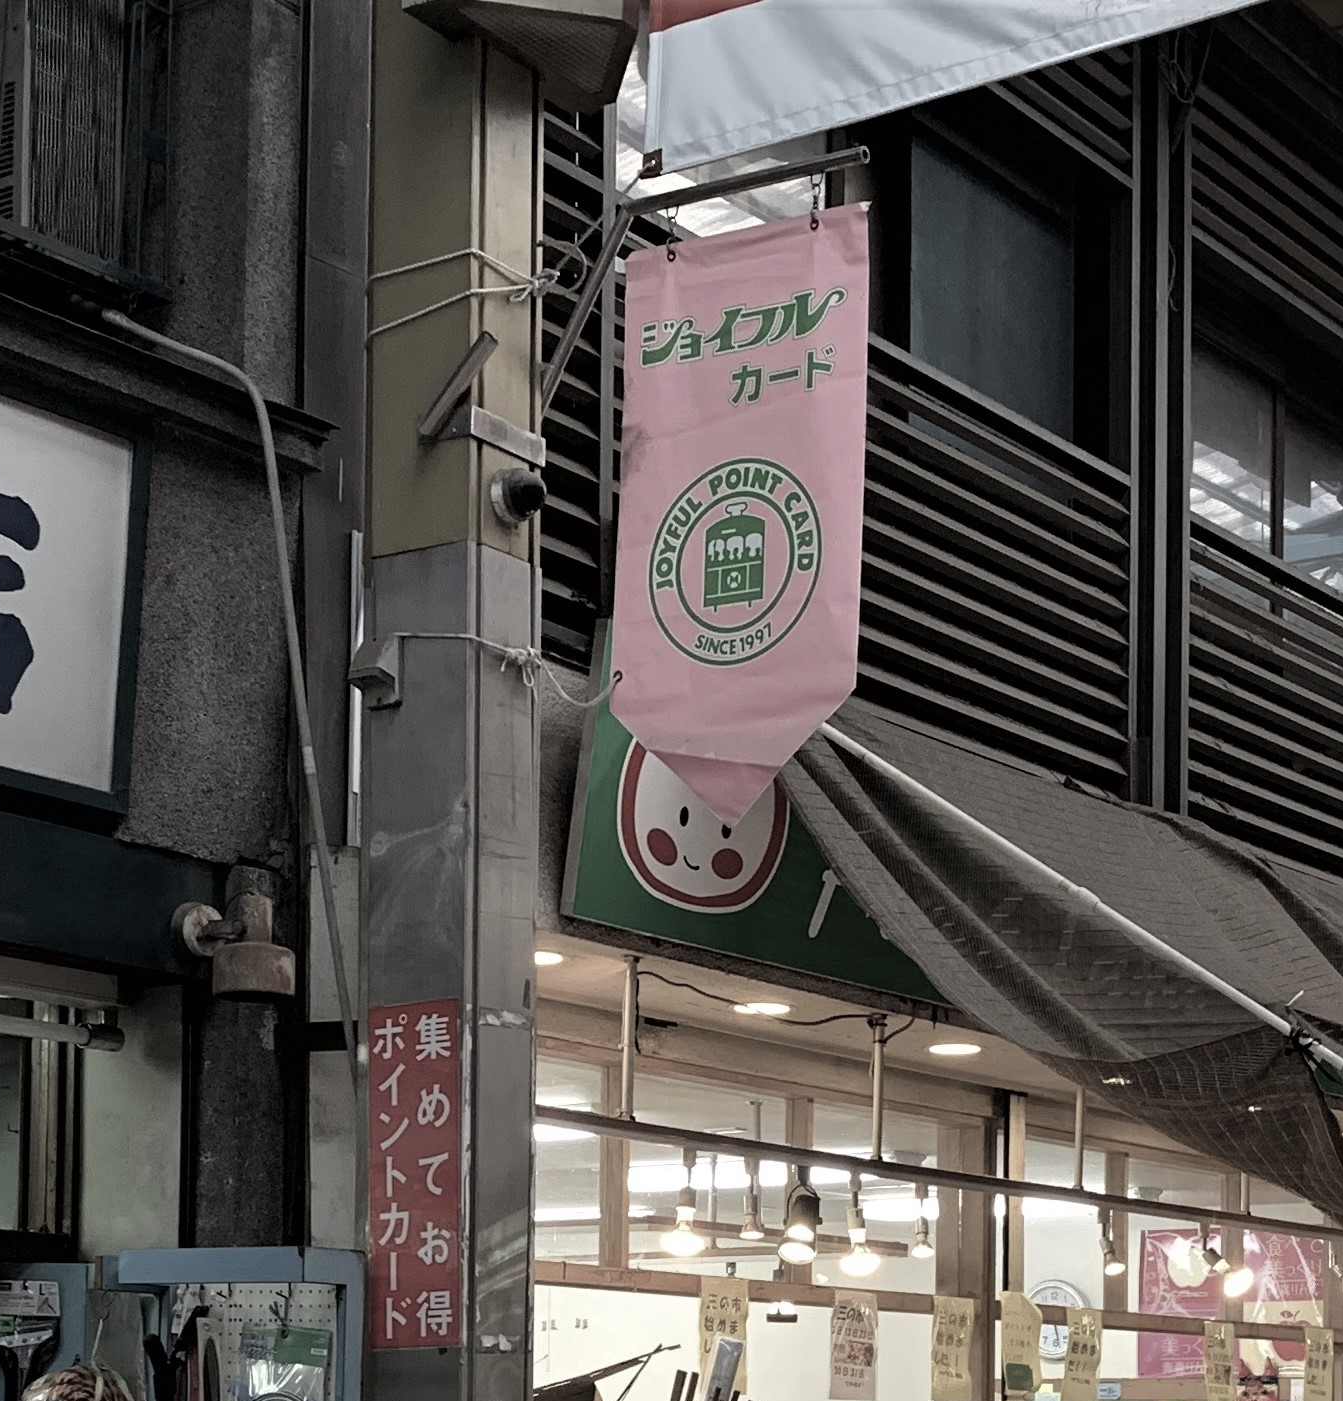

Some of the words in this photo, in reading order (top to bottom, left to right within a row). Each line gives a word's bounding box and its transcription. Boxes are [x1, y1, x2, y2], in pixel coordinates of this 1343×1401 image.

[640, 287, 848, 368] ジョイフル
[729, 344, 837, 407] カード
[655, 497, 703, 592] JOYFUL
[708, 466, 784, 497] POINT
[783, 491, 816, 572] CARD
[694, 633, 737, 656] SINCE
[739, 621, 773, 654] 1997
[372, 1015, 411, 1341] ポイントカード
[414, 1013, 453, 1337] 集めてお得
